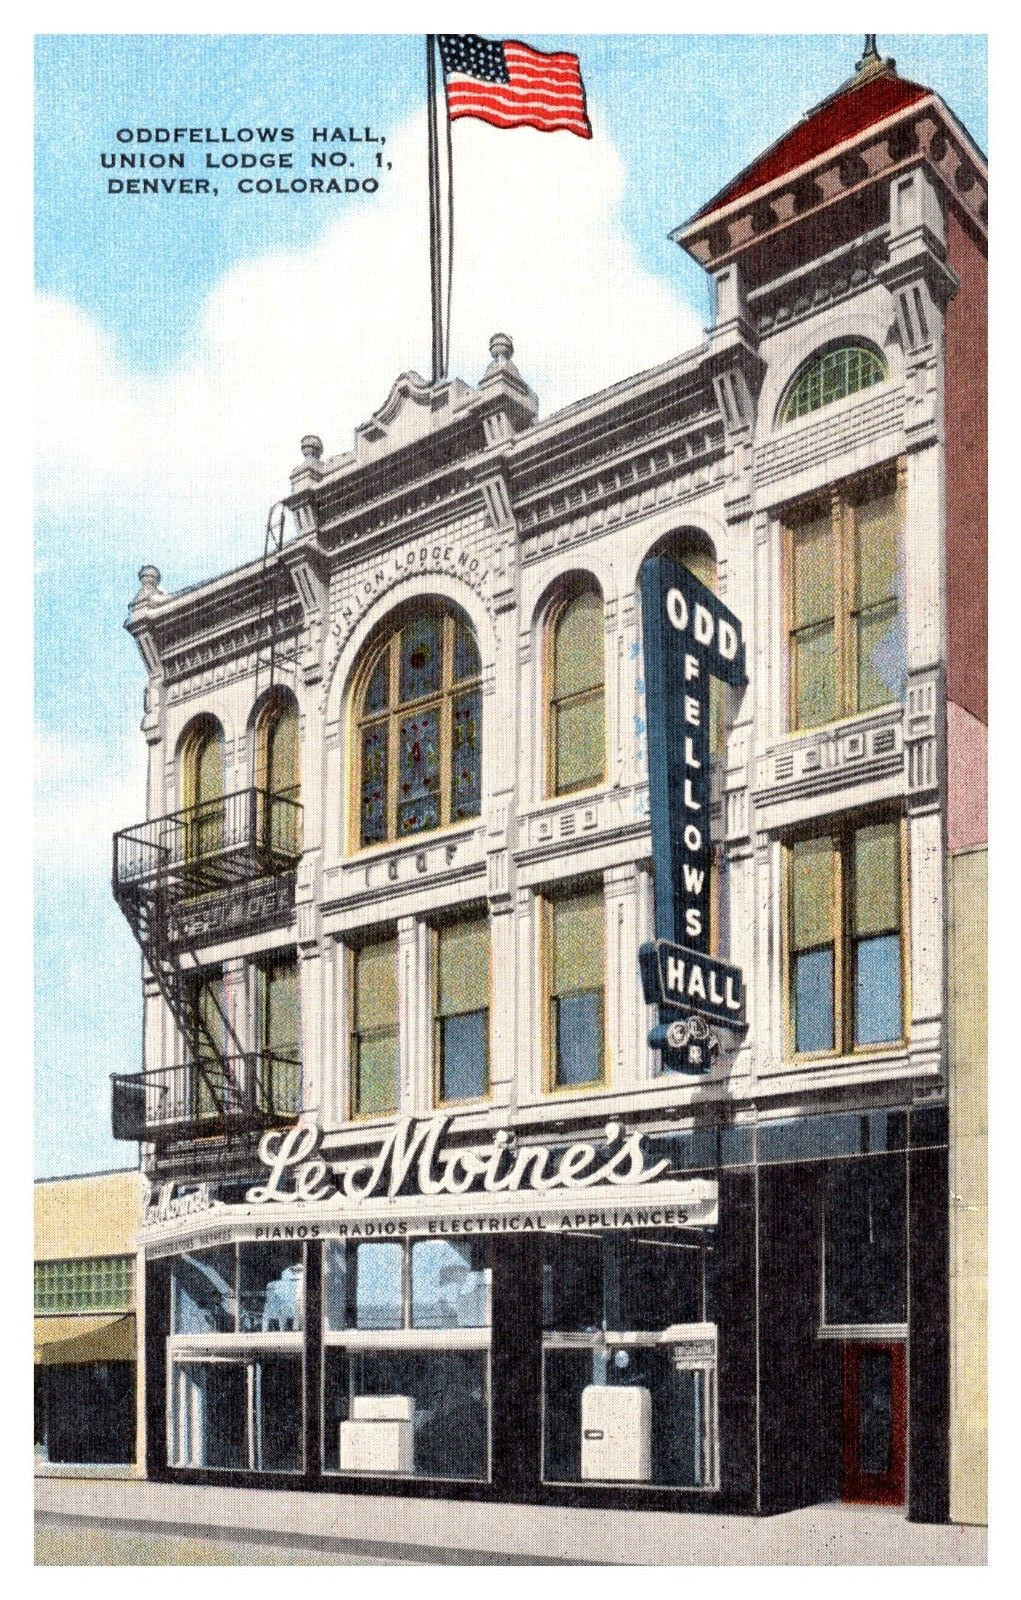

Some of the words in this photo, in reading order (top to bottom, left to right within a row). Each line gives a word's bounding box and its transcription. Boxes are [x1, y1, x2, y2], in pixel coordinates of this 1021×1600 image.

[394, 546, 454, 572] LODGE
[665, 586, 738, 661] ODD
[683, 653, 705, 938] FELLOWS
[667, 955, 741, 1010] HALL
[255, 1225, 321, 1239] PIANOS
[338, 1221, 409, 1236] RADIOS
[428, 1214, 547, 1233] ELECTRICAL
[560, 1209, 689, 1229] APPLIANCES
